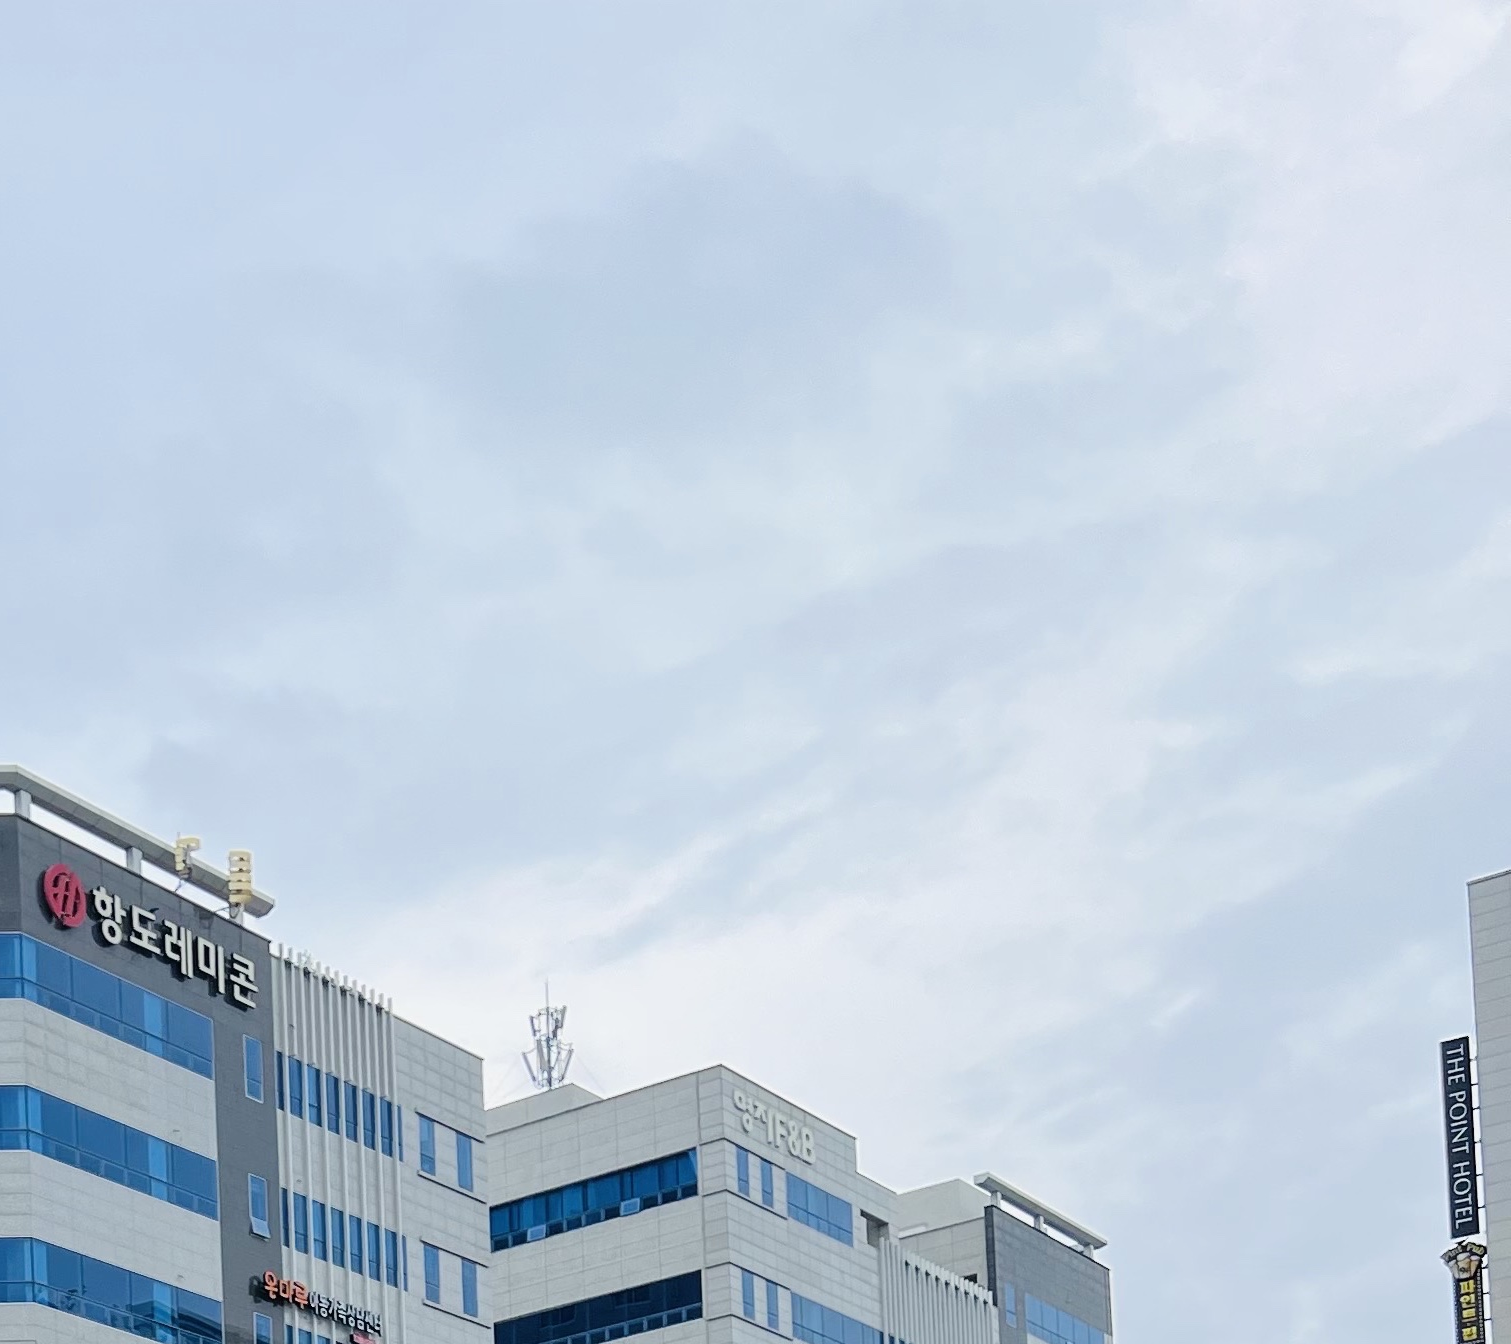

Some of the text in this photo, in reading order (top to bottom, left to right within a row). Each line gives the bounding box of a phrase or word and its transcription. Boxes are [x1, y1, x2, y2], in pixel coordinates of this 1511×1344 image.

[92, 886, 259, 1009] 항도레미콘
[1446, 1043, 1465, 1086] THE
[1448, 1088, 1469, 1153] POINT
[1452, 1160, 1473, 1230] HOTEL
